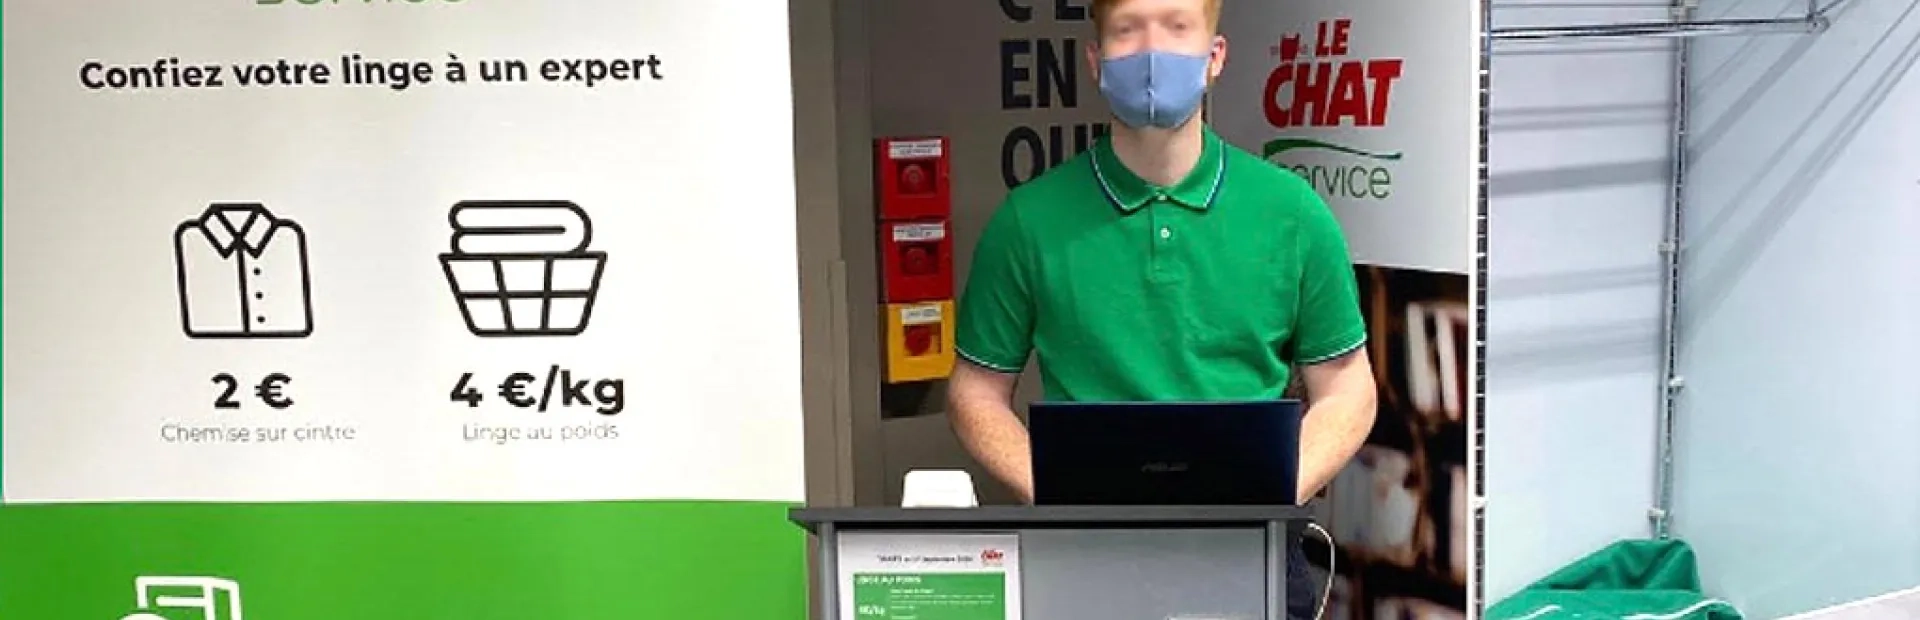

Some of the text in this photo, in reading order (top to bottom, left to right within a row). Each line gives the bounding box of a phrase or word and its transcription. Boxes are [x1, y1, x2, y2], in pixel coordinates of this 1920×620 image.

[1316, 20, 1350, 56] LE
[80, 52, 663, 90] Confiez votre linge à un expert
[1001, 39, 1077, 108] EN
[1264, 60, 1403, 128] CHAT
[1280, 164, 1391, 198] rvice
[211, 373, 294, 409] 2 €
[450, 364, 625, 415] 4 €/kg
[160, 422, 355, 442] Chemise sur cintre
[463, 422, 619, 445] Linge au poids
